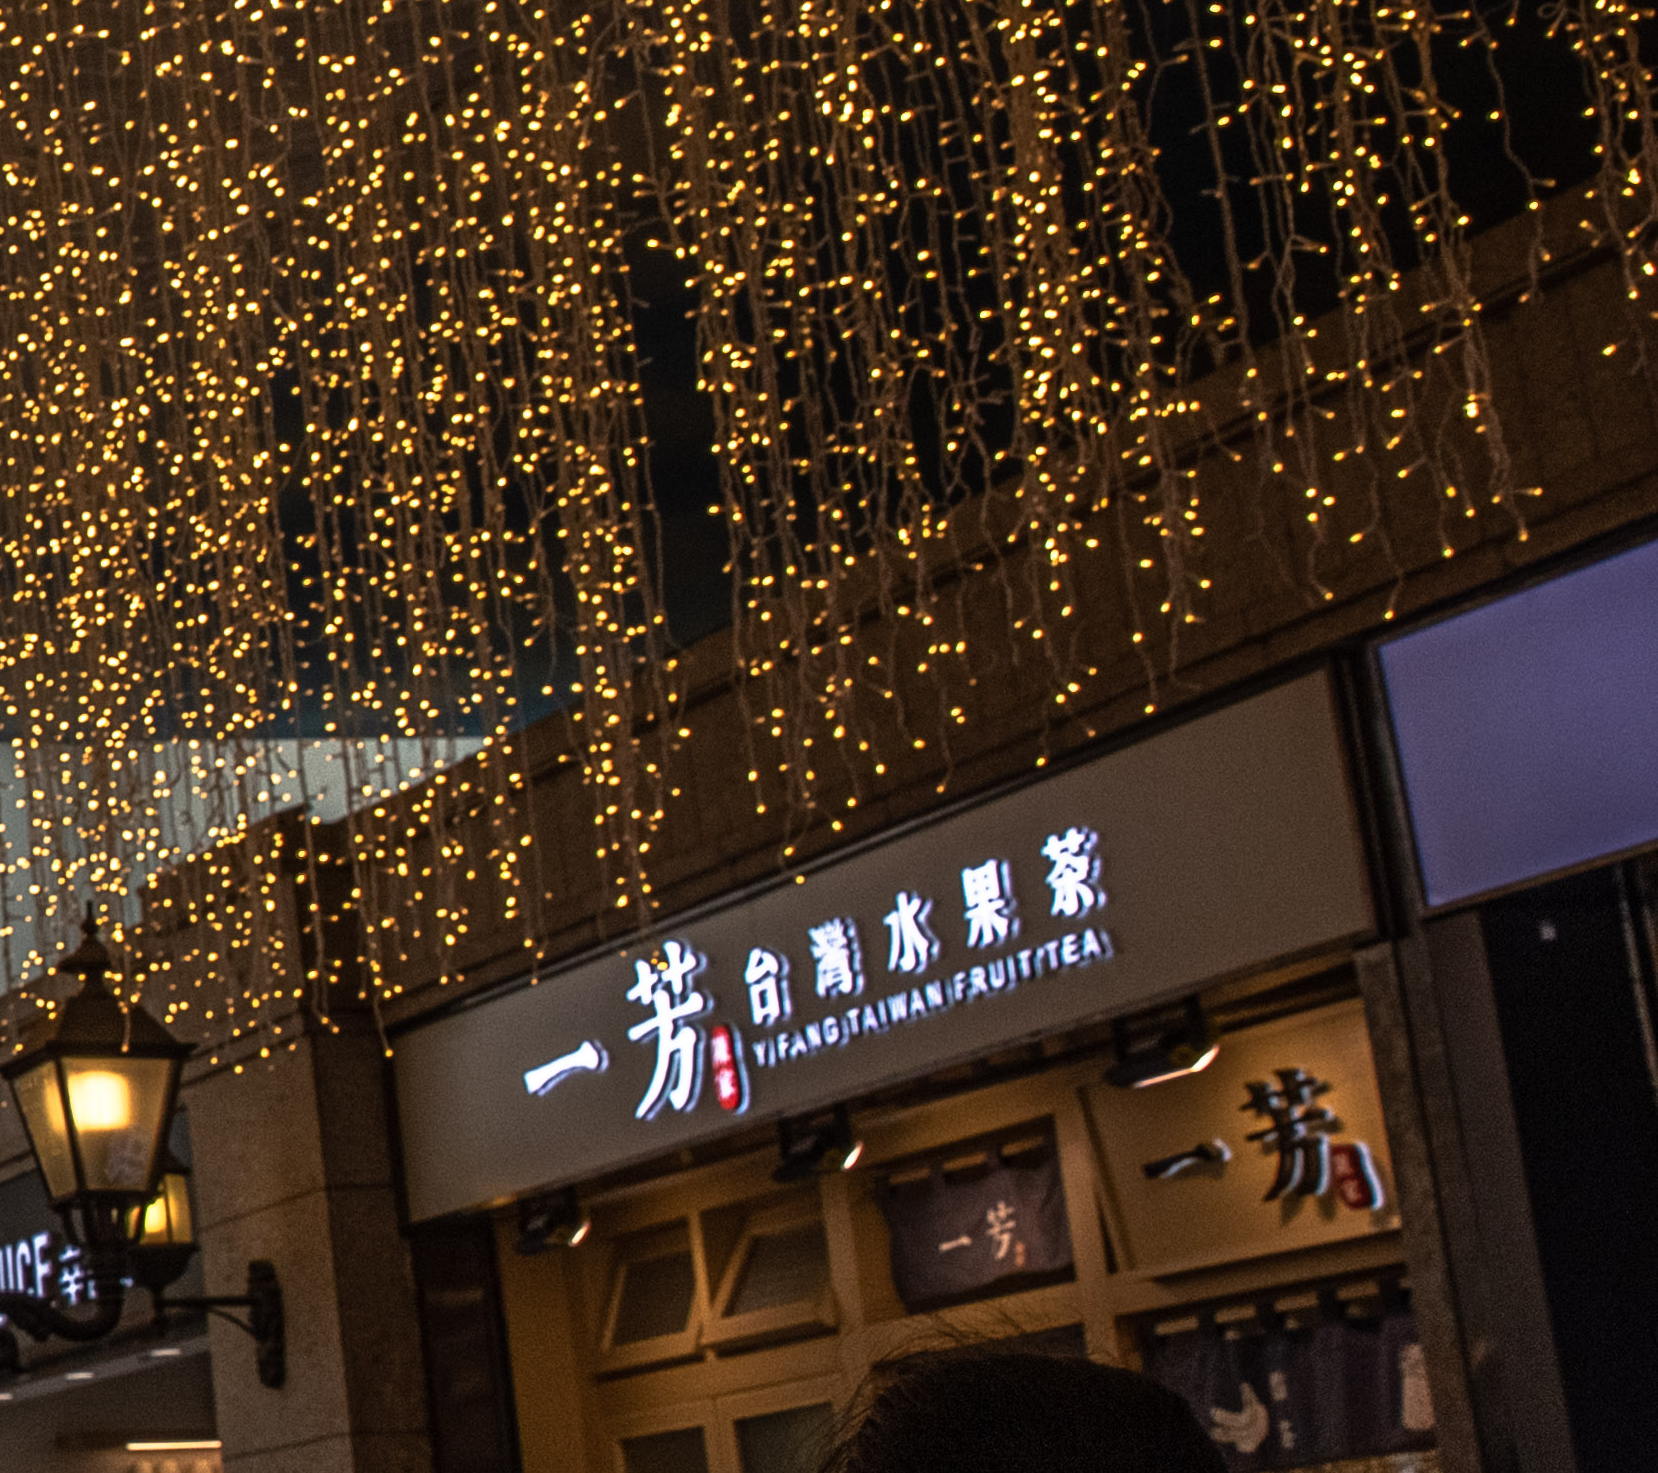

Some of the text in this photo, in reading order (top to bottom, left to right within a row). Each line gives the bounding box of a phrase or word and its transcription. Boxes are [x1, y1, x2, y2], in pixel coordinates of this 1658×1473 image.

[745, 827, 1097, 1026] 台灣水果茶
[524, 940, 707, 1120] 一芳
[753, 928, 1105, 1067] YIFANG TAIWAN FRUIT TEA
[1142, 1068, 1345, 1203] 一芳
[939, 1201, 1018, 1261] 一芳
